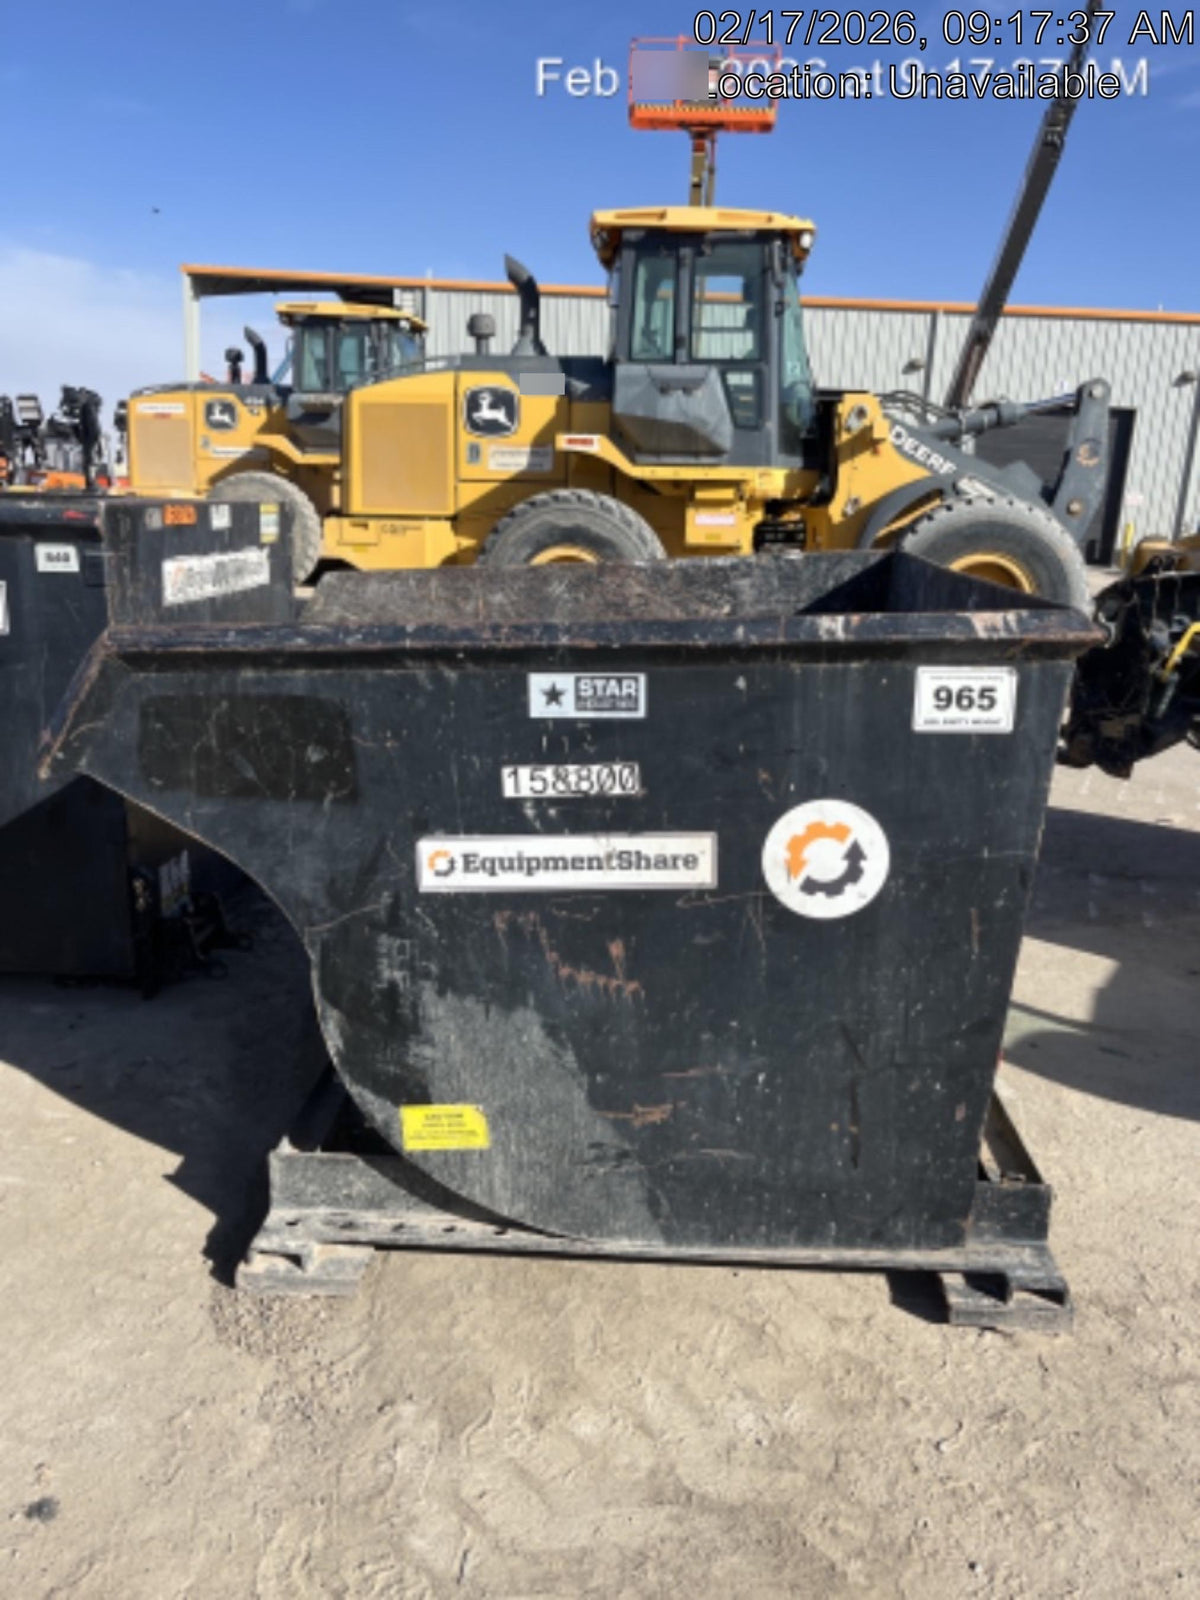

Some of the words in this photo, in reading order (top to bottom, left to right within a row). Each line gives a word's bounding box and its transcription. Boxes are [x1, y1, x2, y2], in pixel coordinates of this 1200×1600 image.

[578, 678, 636, 697] STAR
[933, 685, 997, 711] 965
[461, 850, 698, 876] EquipmentShare
